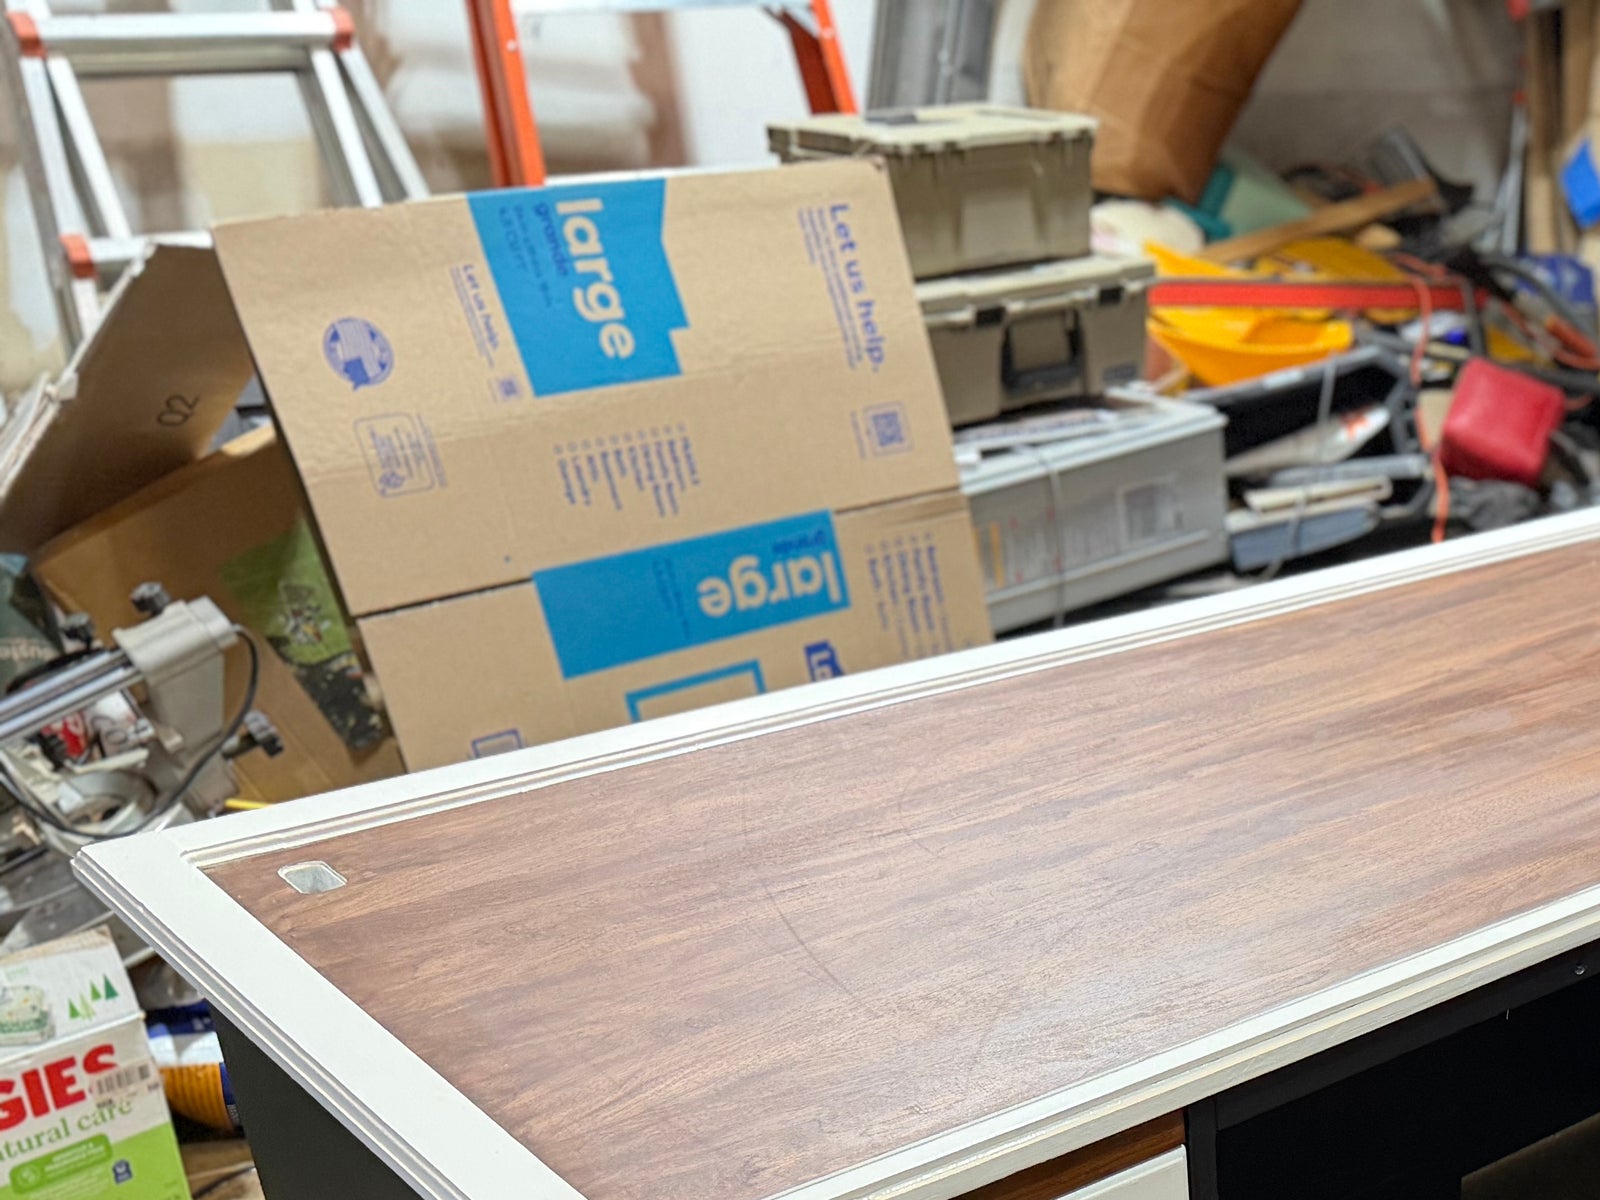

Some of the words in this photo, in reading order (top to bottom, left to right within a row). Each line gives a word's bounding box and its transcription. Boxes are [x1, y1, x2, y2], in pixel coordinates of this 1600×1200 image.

[534, 202, 569, 277] grande
[555, 198, 635, 359] large
[829, 204, 858, 253] Let
[845, 260, 865, 294] us
[856, 300, 886, 373] help.
[697, 552, 842, 618] large
[77, 1100, 132, 1131] care
